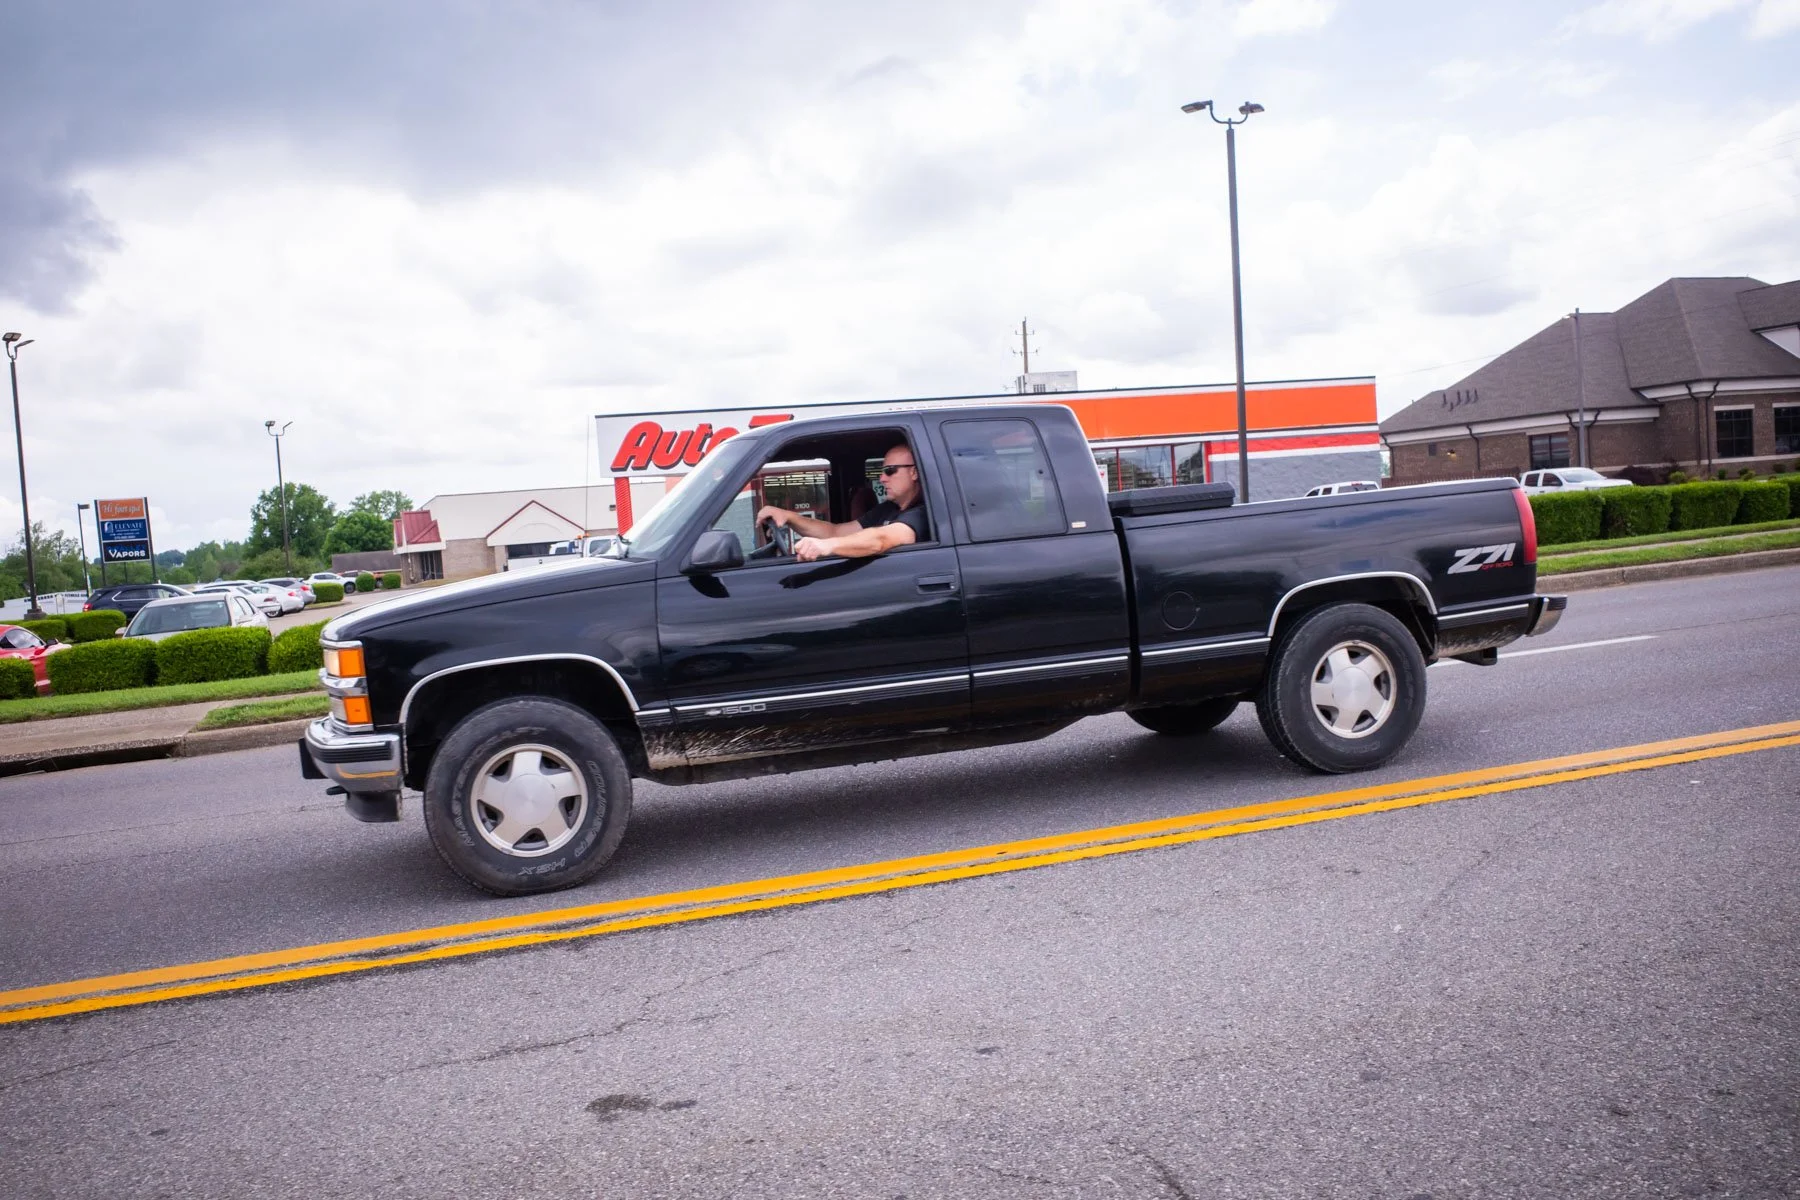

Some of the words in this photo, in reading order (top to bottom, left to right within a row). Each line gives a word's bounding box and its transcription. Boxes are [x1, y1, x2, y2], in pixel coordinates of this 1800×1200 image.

[611, 414, 794, 472] Auto
[114, 522, 144, 530] ELEVATE
[108, 549, 146, 559] VAPORS
[1447, 542, 1517, 575] Z71
[722, 703, 767, 715] 1500
